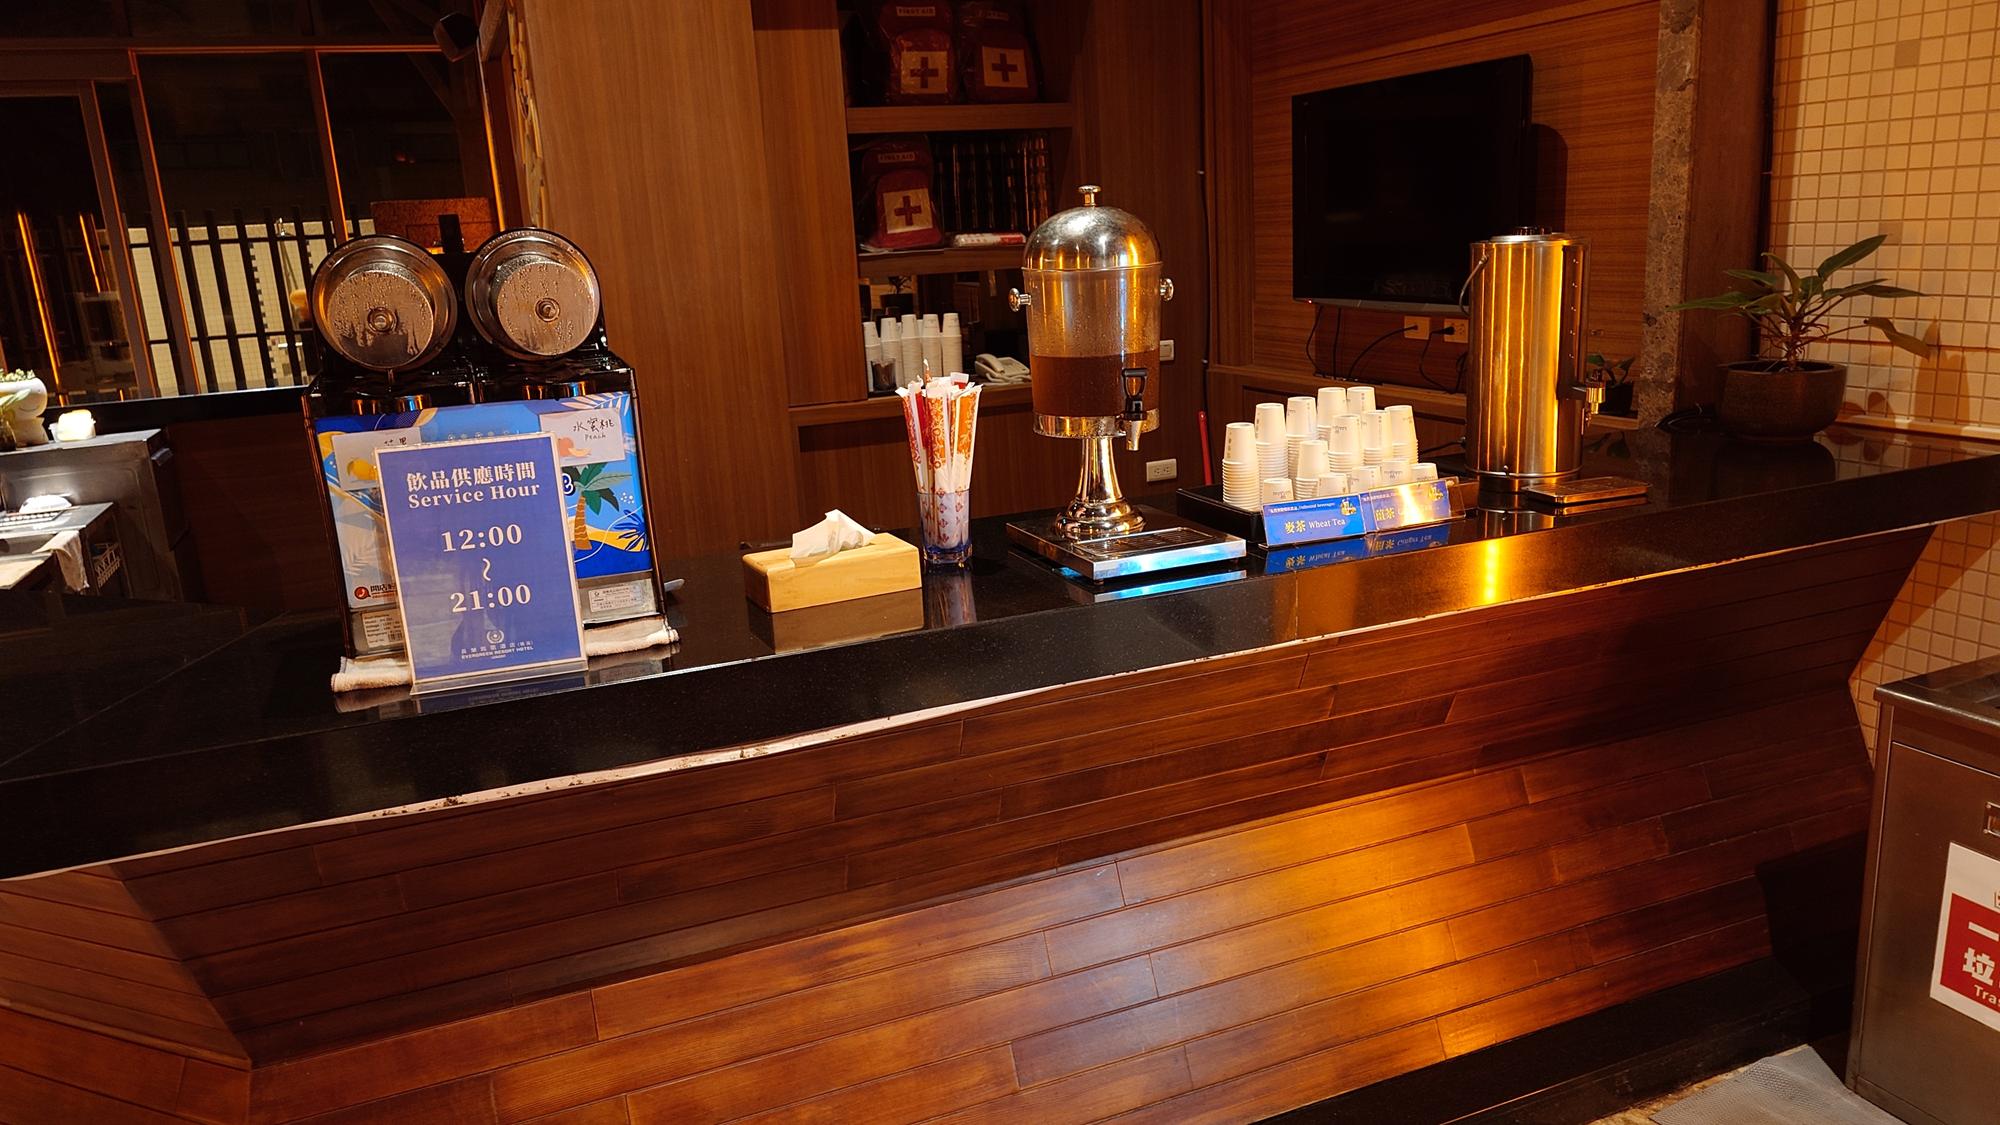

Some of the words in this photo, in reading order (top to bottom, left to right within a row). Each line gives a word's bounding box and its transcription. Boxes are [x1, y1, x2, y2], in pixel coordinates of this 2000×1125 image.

[572, 417, 615, 432] 水蜜桃
[406, 461, 536, 493] 飲品供應時間
[408, 488, 484, 509] Service
[490, 484, 540, 500] Hour
[1309, 520, 1331, 529] Wheat
[1332, 518, 1346, 526] Tea
[441, 524, 523, 552] 12:00
[450, 584, 532, 613] 21:00
